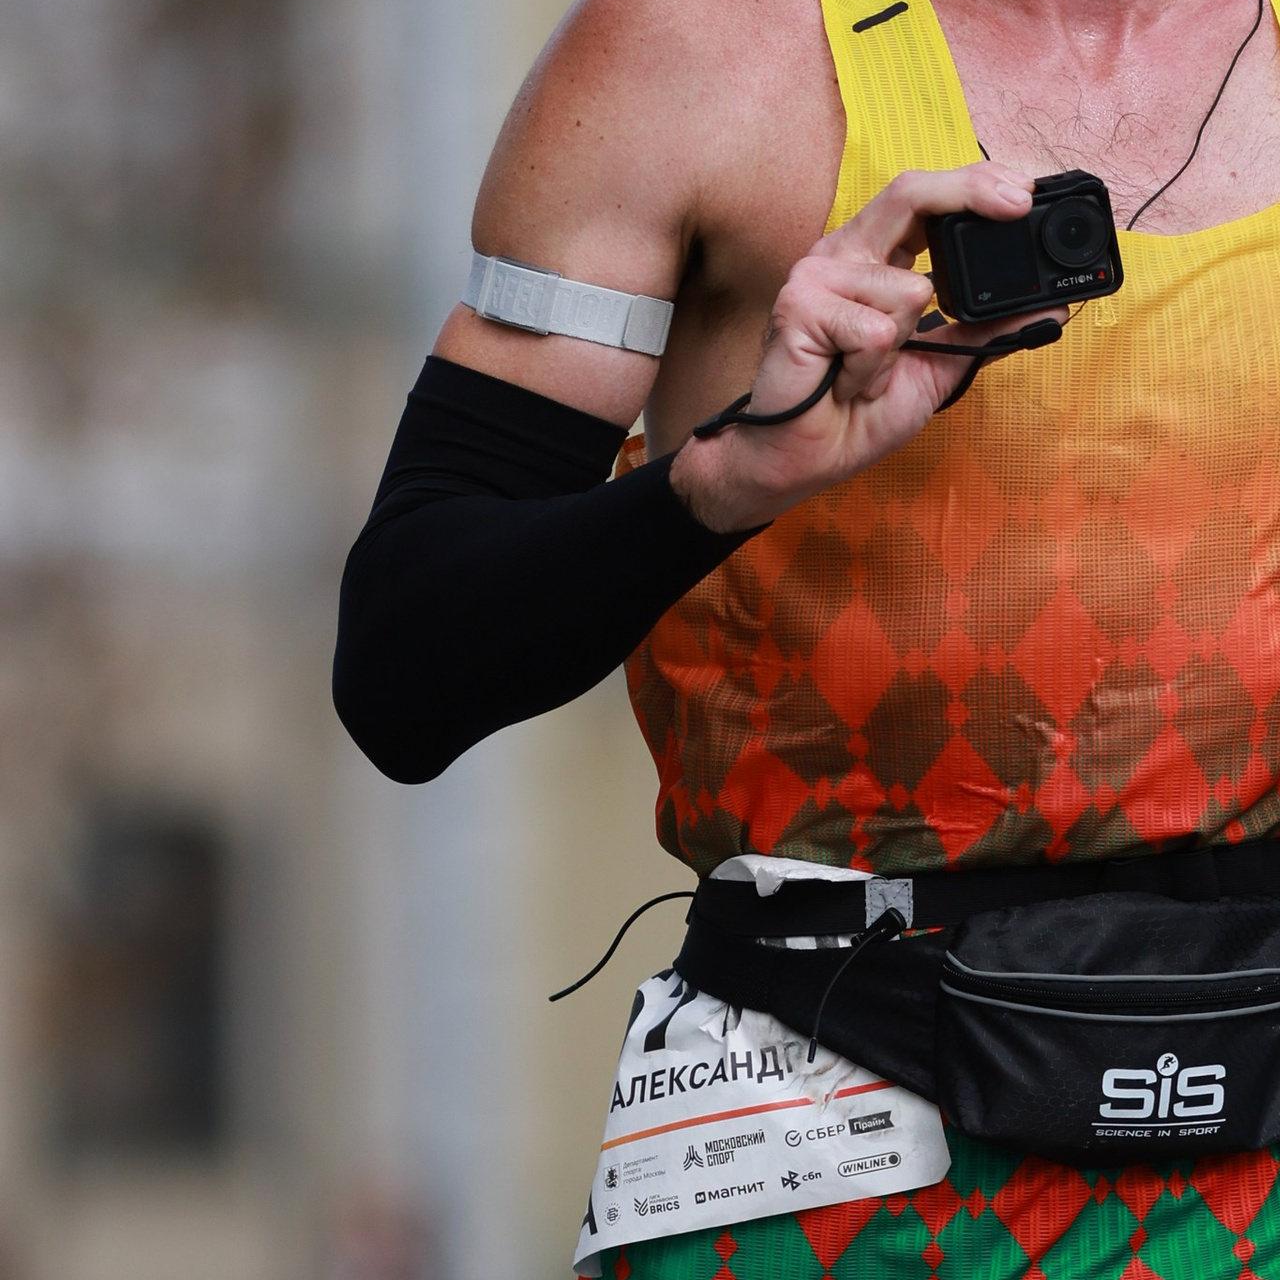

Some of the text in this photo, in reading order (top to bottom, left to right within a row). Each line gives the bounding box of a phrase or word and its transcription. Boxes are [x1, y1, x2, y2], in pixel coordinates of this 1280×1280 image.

[1056, 273, 1093, 288] ACTION
[806, 1116, 886, 1141] СБЕР Прайм
[1095, 1125, 1221, 1137] SCIENCE IN SPORT
[705, 1129, 766, 1154] МОСКОВСКИЙ
[623, 1154, 659, 1169] Департамент
[707, 1150, 735, 1167] СПОРТ
[842, 1156, 887, 1174] WINLINE
[623, 1168, 641, 1177] спорта
[623, 1169, 666, 1185] города Москвы
[650, 1201, 680, 1215] BRICS
